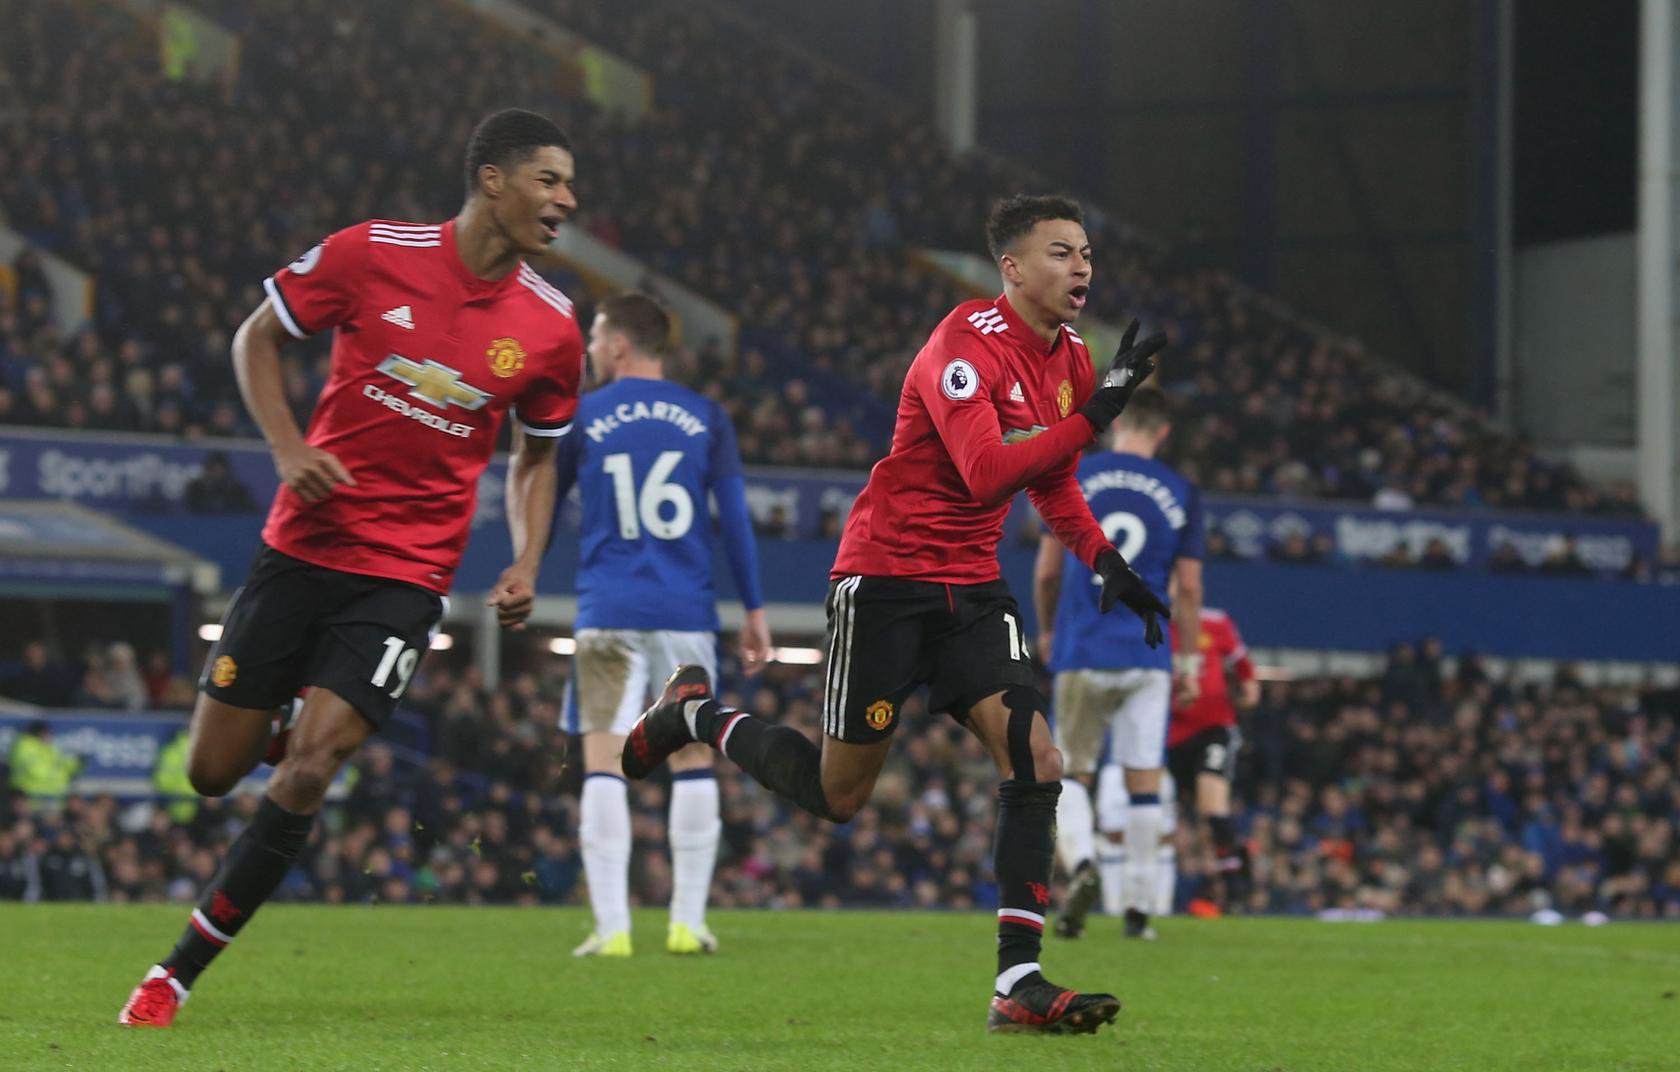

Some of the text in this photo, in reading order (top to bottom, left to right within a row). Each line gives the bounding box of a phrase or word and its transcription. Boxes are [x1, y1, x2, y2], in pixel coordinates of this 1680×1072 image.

[363, 384, 476, 438] CHEVROLET
[585, 400, 707, 443] McCARTHY
[603, 451, 693, 540] 16
[1092, 511, 1148, 585] 2
[1003, 612, 1030, 661] 1
[371, 636, 419, 699] 19
